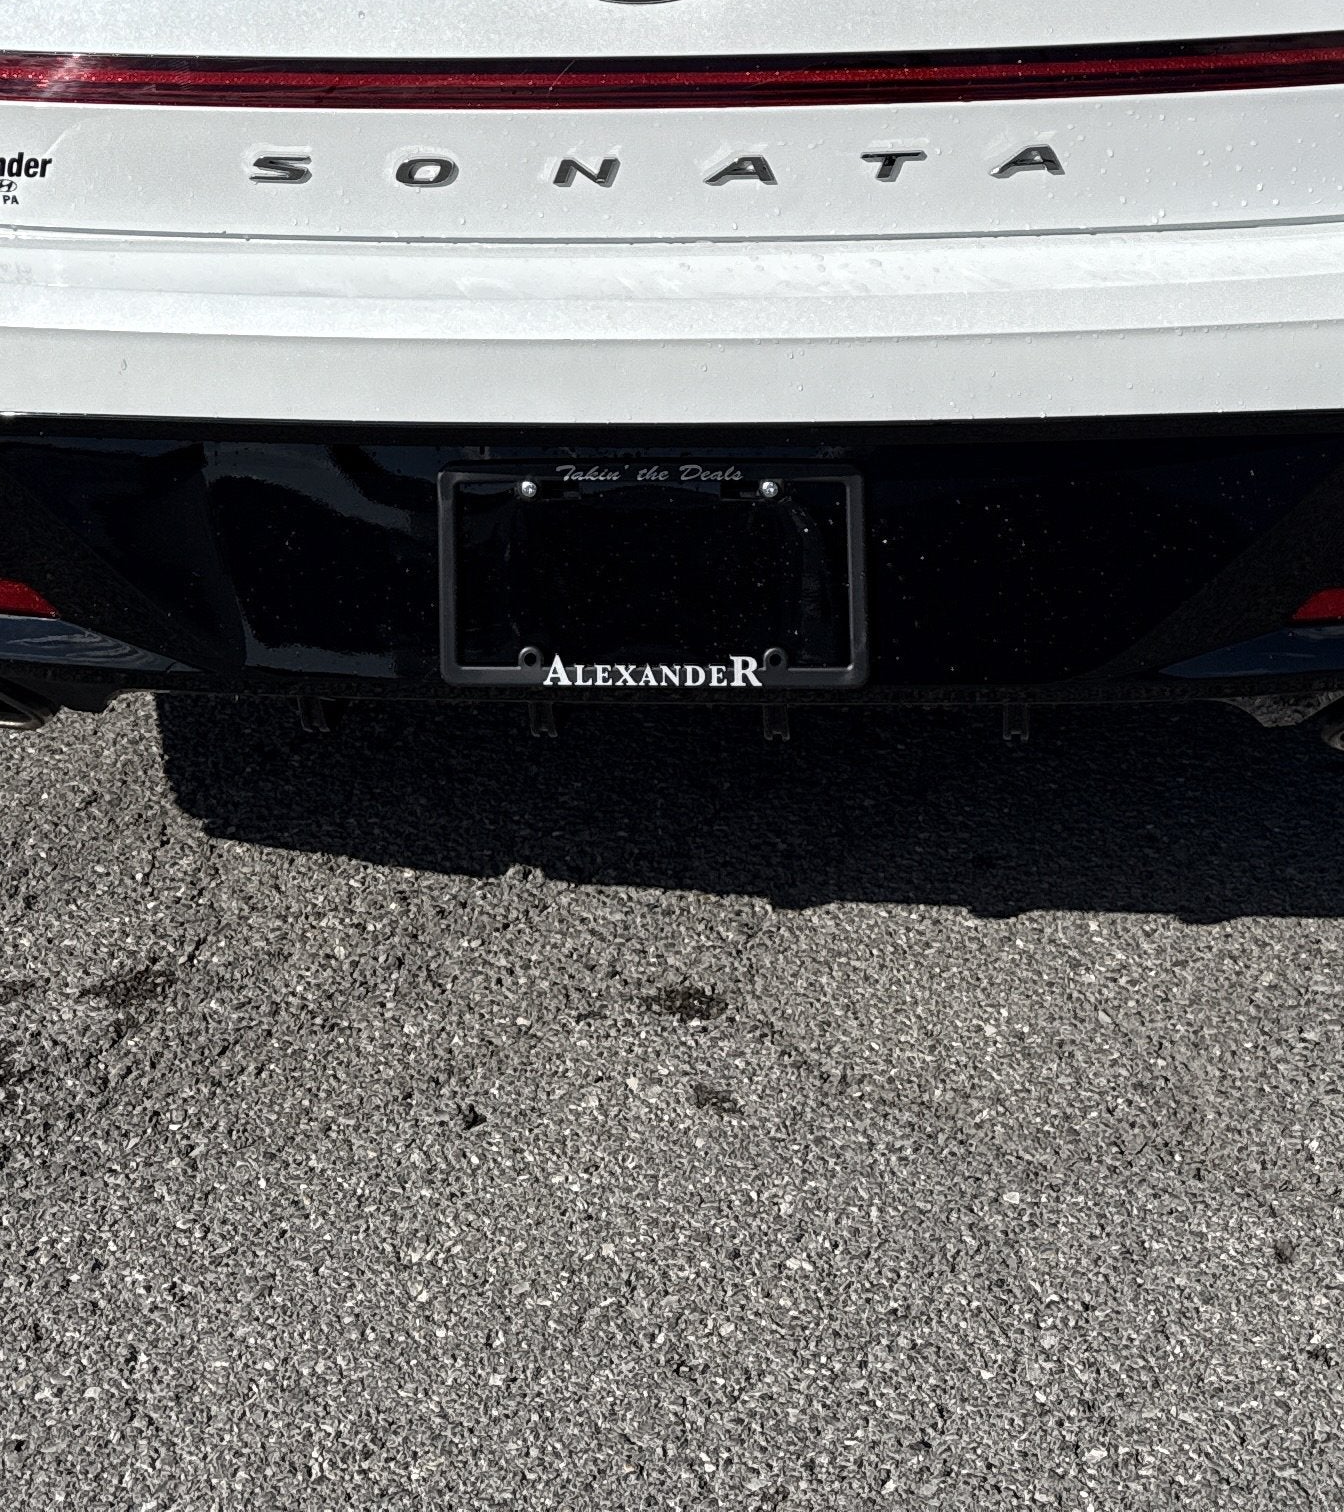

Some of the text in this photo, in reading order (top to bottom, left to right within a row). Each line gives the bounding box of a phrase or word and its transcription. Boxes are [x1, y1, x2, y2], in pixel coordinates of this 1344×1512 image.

[248, 143, 1065, 188] SONATA
[3, 194, 19, 205] PA
[556, 464, 743, 481] Takin' the Deals
[543, 653, 762, 686] ALEXANDER
